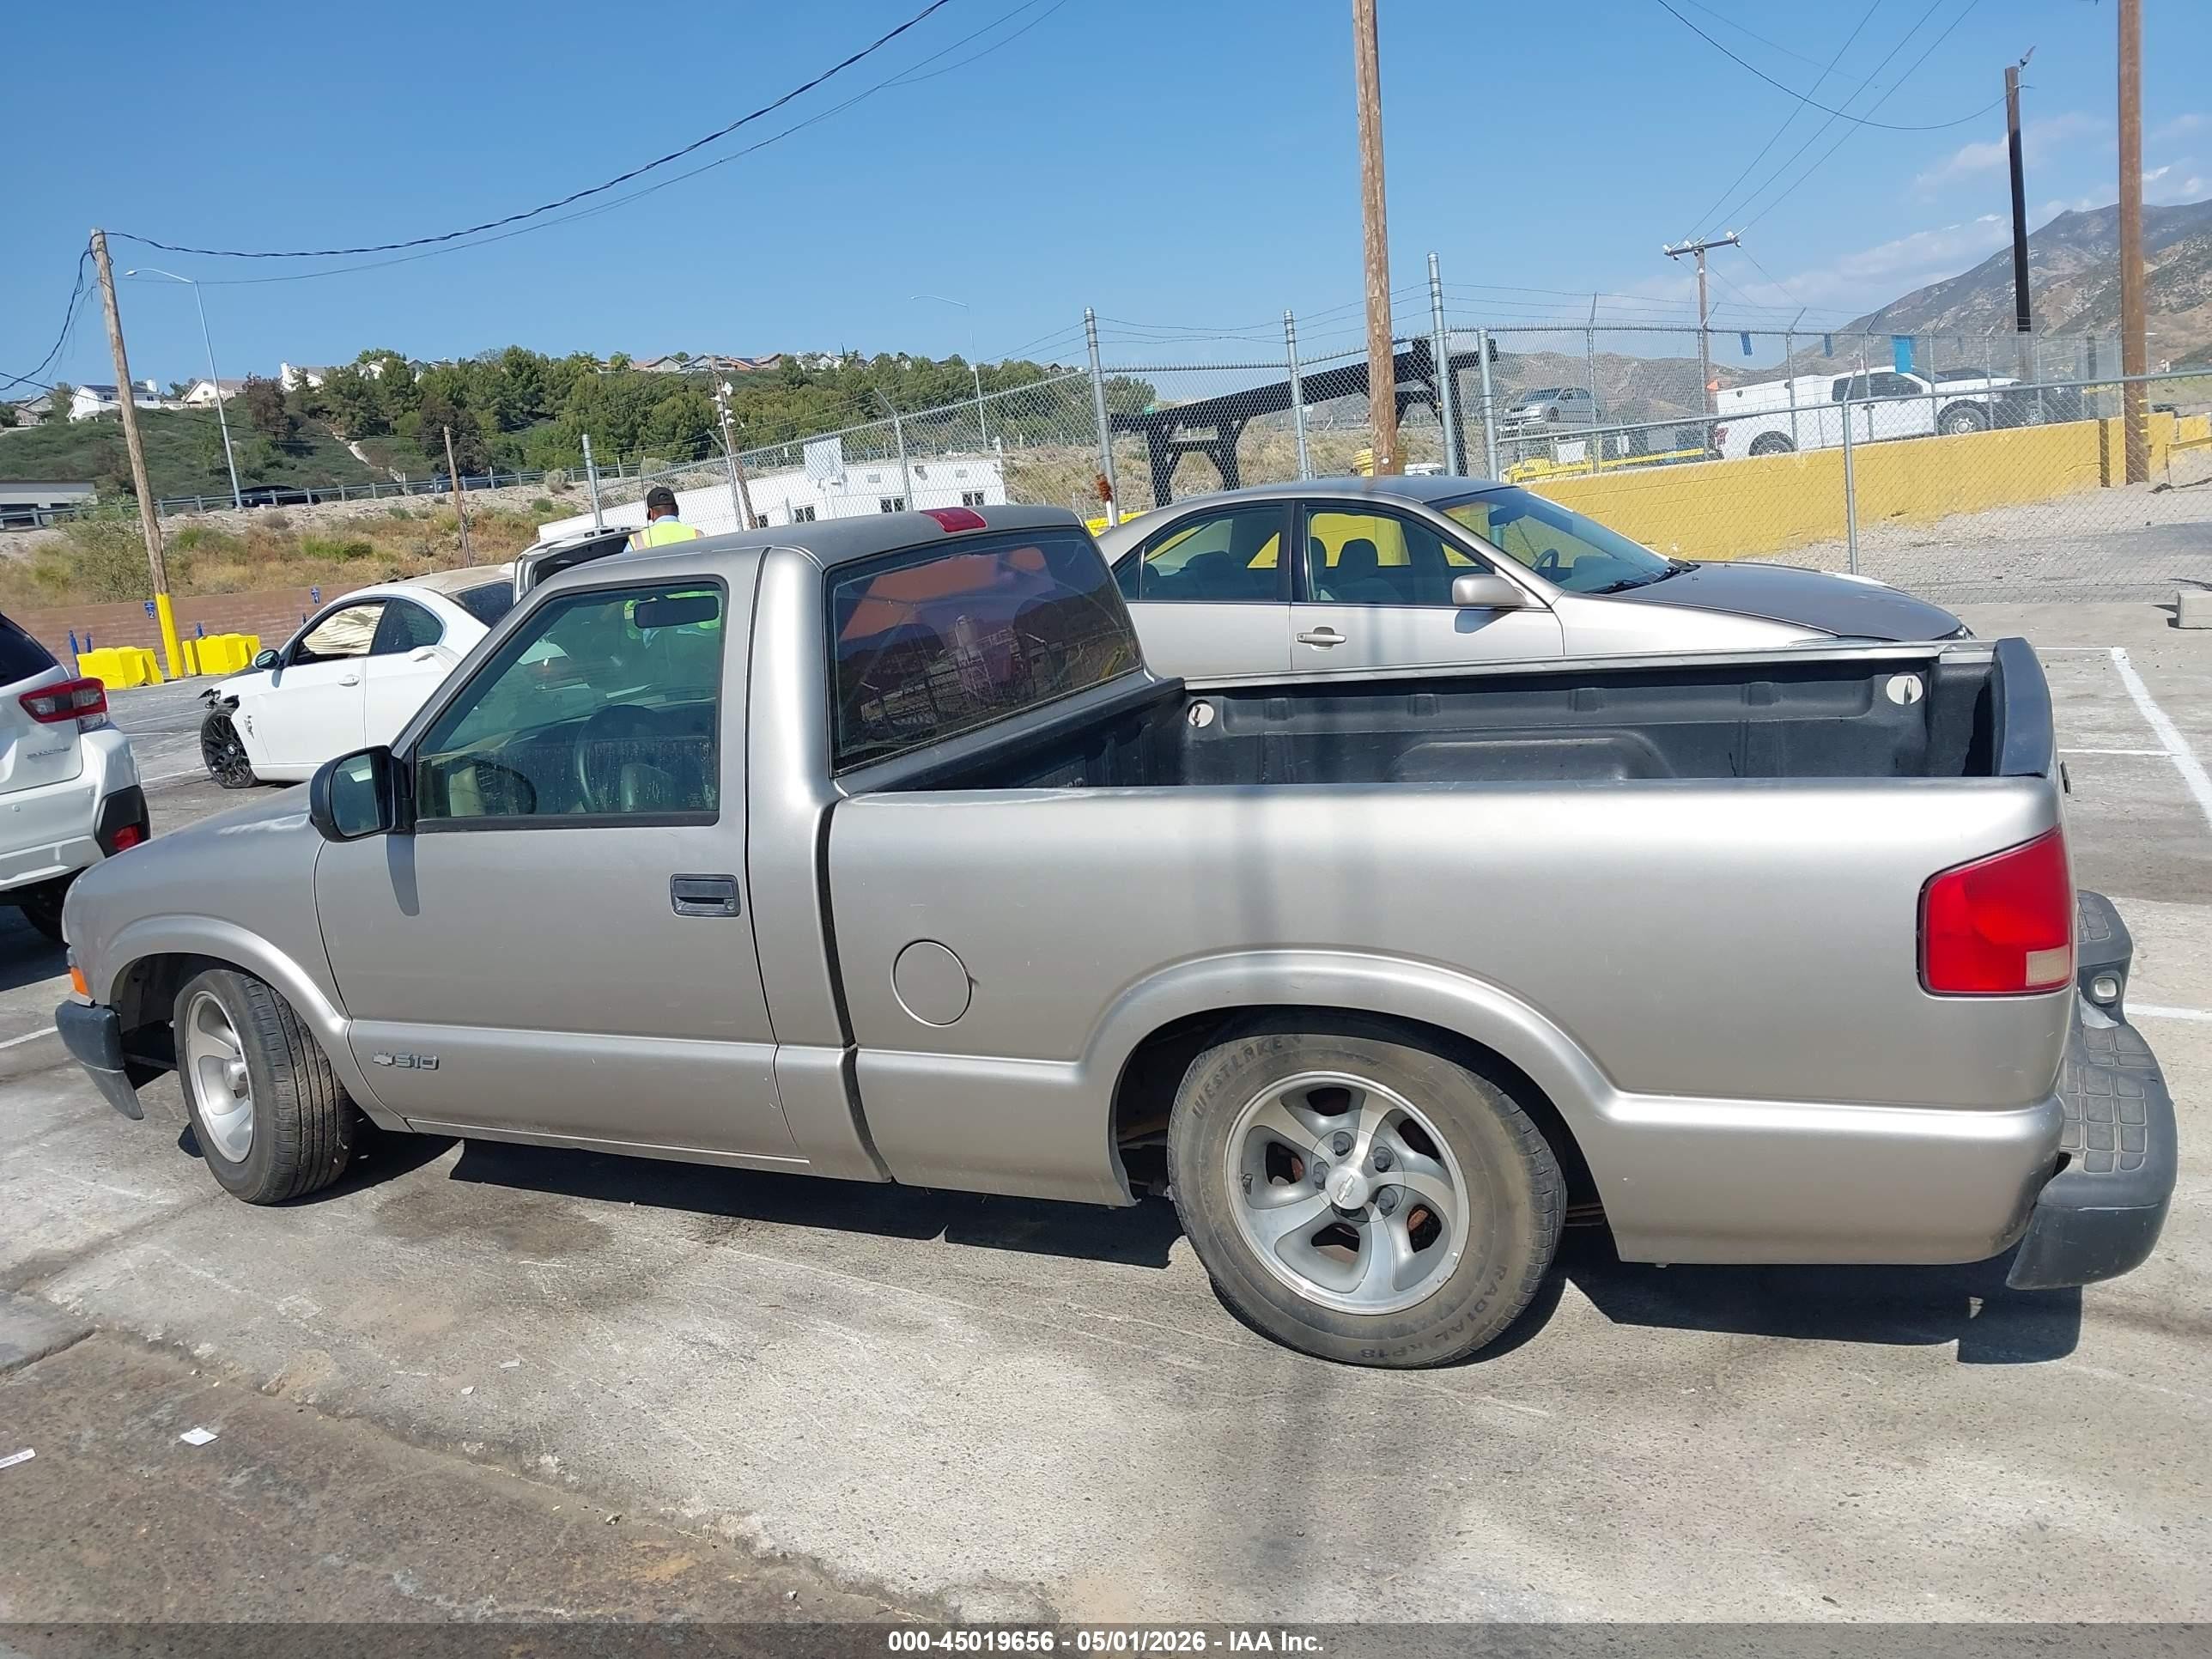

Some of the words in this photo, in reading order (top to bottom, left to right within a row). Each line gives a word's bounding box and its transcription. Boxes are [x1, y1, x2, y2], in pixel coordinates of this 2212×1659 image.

[395, 1053, 440, 1071] S10
[1192, 1036, 1283, 1119] WESTLAKE
[1435, 1265, 1508, 1341] RADIAL
